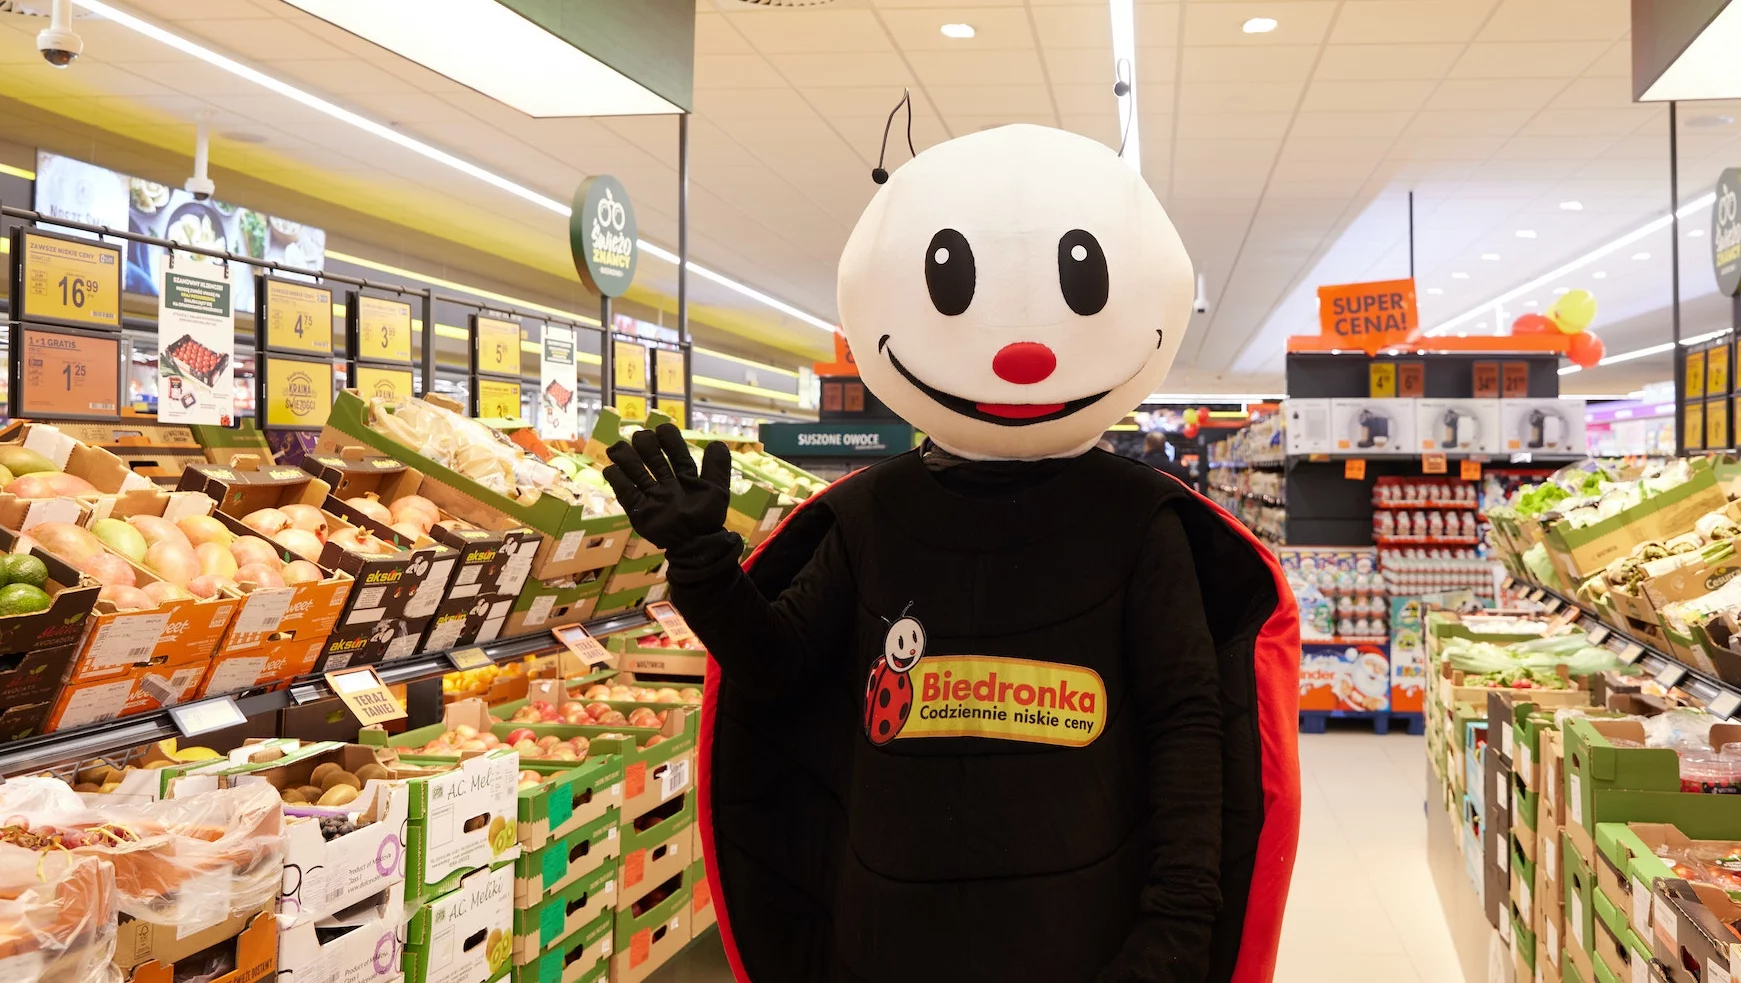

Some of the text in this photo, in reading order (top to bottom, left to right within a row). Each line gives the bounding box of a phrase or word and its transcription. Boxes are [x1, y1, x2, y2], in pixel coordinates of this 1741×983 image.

[30, 243, 57, 253] ZAWSZE
[57, 248, 78, 257] NISKIE
[58, 275, 85, 308] 16
[86, 280, 99, 293] 99
[1333, 293, 1404, 316] SUPER
[294, 314, 313, 339] 4 75
[1334, 312, 1408, 336] CENA!
[29, 336, 34, 344] 1
[41, 338, 45, 346] 1
[47, 339, 76, 349] GRATIS
[381, 325, 389, 349] 3
[495, 344, 502, 364] 5
[63, 364, 86, 391] 1 25
[1376, 375, 1384, 389] 4
[288, 383, 311, 394] KRAINA
[798, 433, 880, 446] SUSZONE OWOCE
[467, 549, 497, 562] aksun
[366, 569, 403, 583] aksun
[285, 599, 314, 614] weet
[329, 637, 368, 652] aksun
[353, 692, 388, 706] TERAZ
[921, 670, 1096, 714] Biedronka
[362, 703, 396, 718] TANIEJ
[920, 703, 1094, 734] Codziennie niskie ceny
[447, 764, 492, 801] A.C. Mel
[448, 899, 467, 922] A.C.
[470, 876, 504, 910] Meliki
[251, 957, 274, 979] DOSTAWY
